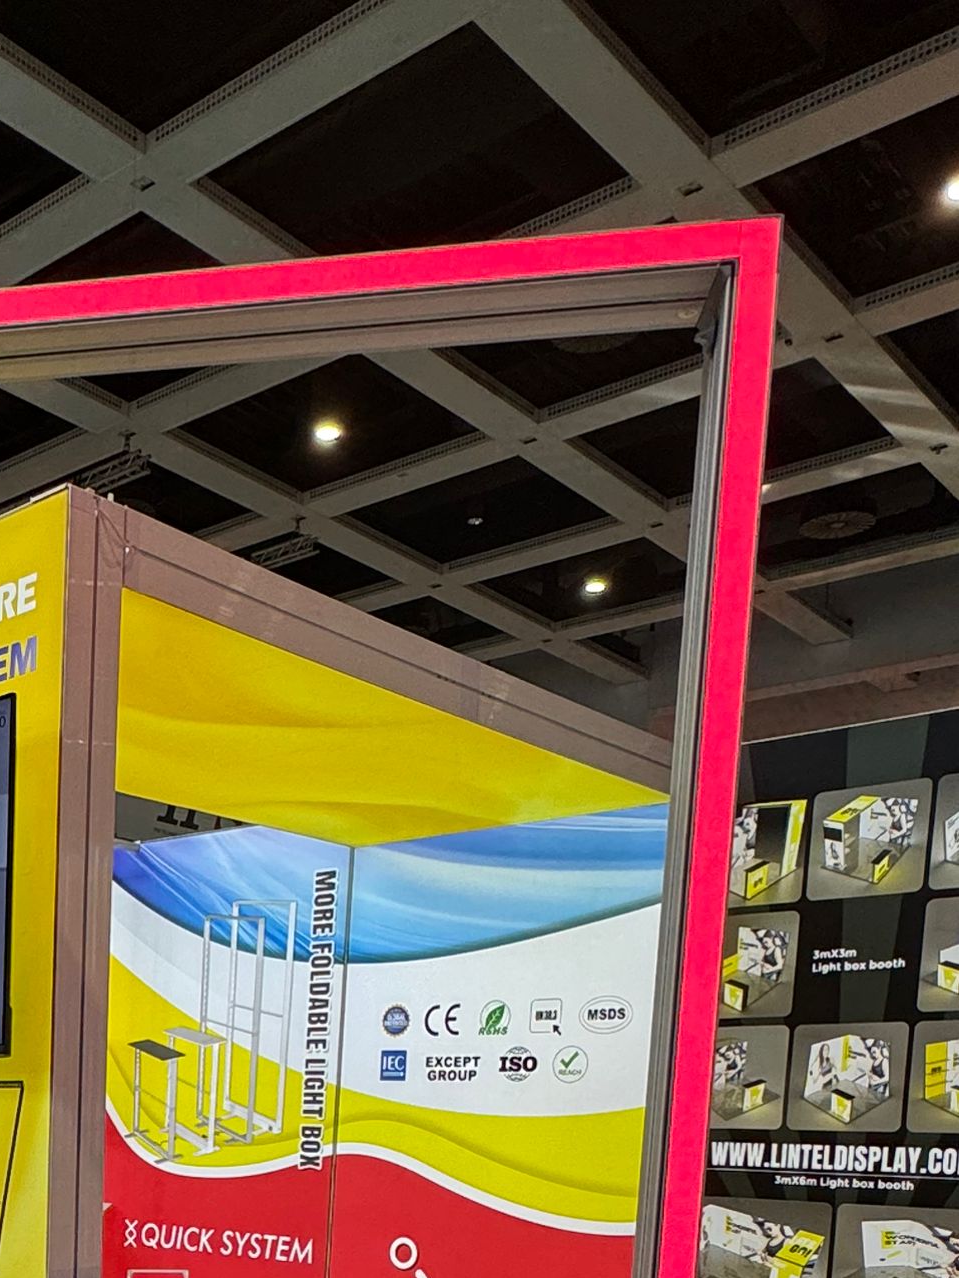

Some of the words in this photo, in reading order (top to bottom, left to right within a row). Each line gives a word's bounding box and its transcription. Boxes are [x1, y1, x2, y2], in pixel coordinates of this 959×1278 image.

[312, 870, 337, 937] MORE
[812, 948, 857, 959] 3mX3m
[812, 962, 841, 974] Light
[844, 961, 866, 971] box
[869, 958, 906, 970] booth
[306, 943, 332, 1051] FOLDABLE
[424, 1003, 461, 1036] CE
[587, 1008, 626, 1021] MSDS
[382, 1055, 405, 1071] IEC
[425, 1056, 481, 1067] EXCEPT
[498, 1055, 538, 1072] ISO
[427, 1070, 477, 1081] GROUP
[302, 1059, 326, 1118] LIGHT
[299, 1125, 323, 1169] BOX
[711, 1141, 959, 1176] WWW.LINTELDISPLAY.CO
[820, 1176, 850, 1190] Light
[852, 1178, 875, 1189] box
[878, 1179, 915, 1191] booth
[141, 1222, 215, 1253] QUICK
[220, 1230, 313, 1265] SYSTEM
